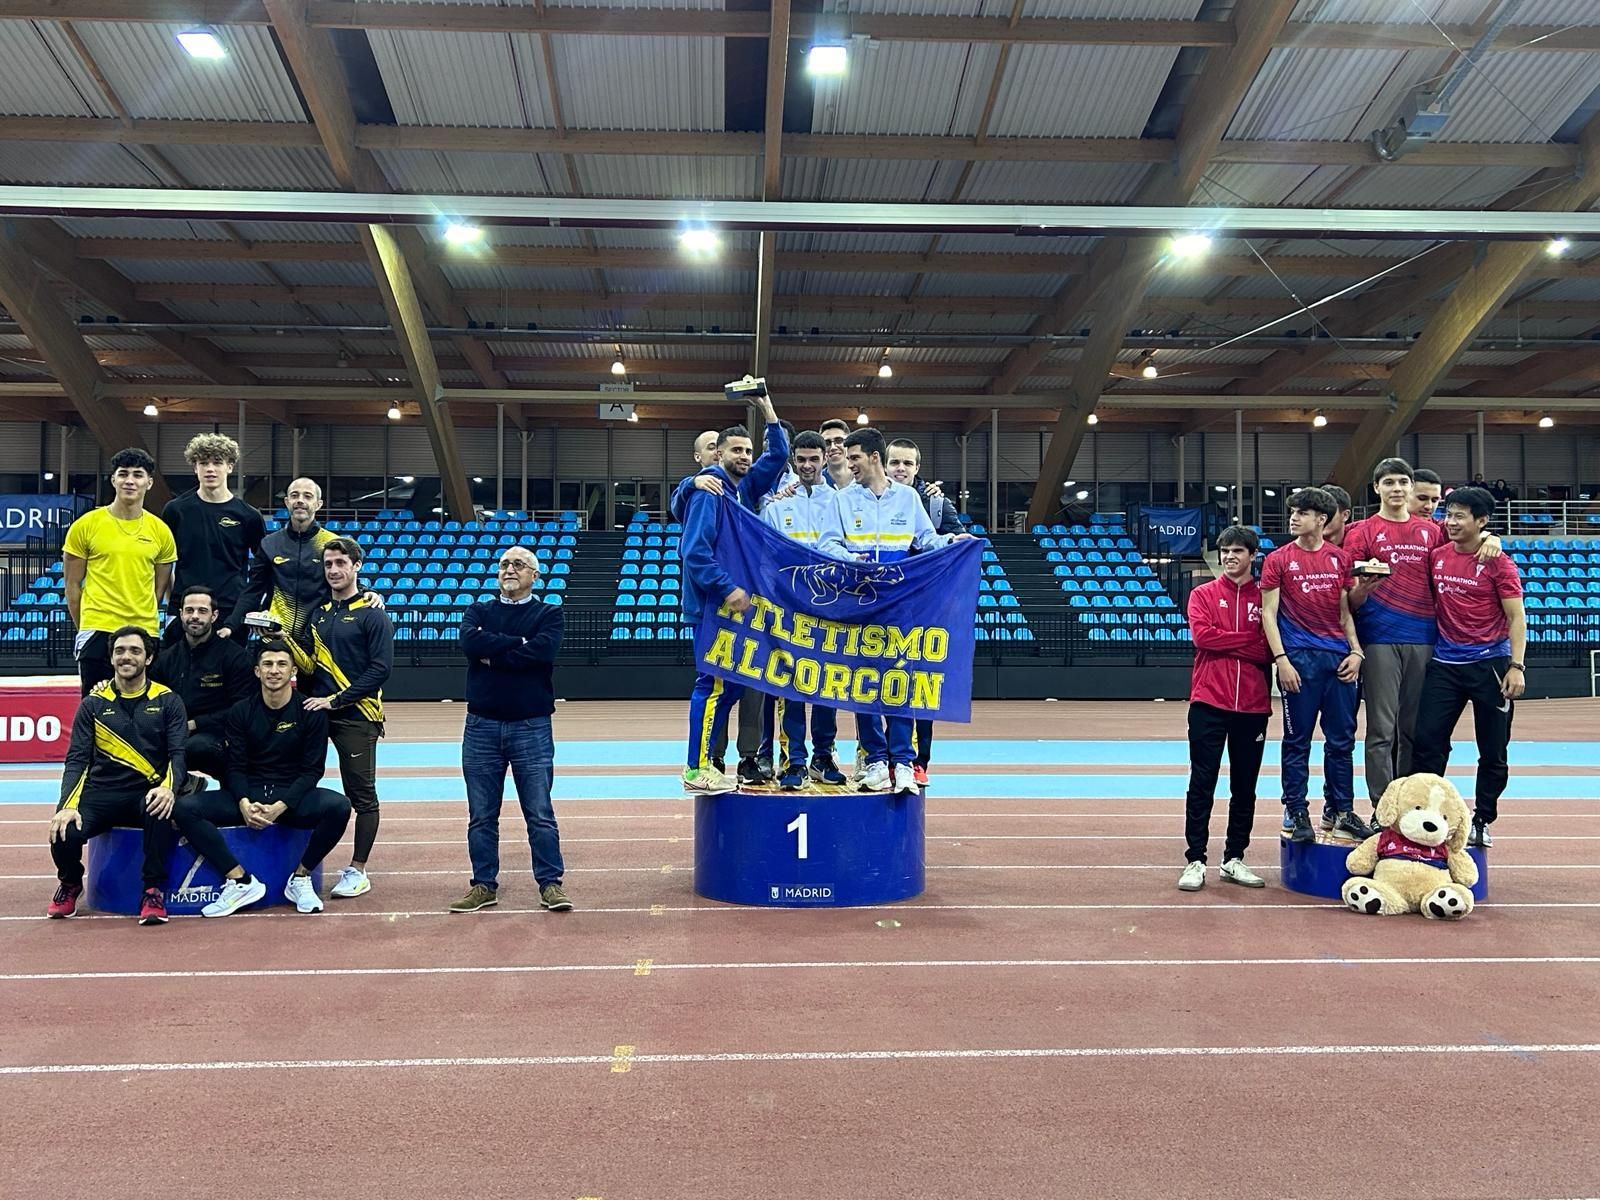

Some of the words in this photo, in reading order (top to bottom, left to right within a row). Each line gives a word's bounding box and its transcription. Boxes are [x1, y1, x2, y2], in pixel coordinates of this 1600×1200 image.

[1395, 544, 1429, 552] MARATHON
[1443, 575, 1478, 586] MARATHON
[717, 594, 950, 662] ATLETISMO
[704, 629, 945, 710] ALCORCÓN
[787, 813, 808, 859] 1
[170, 892, 222, 903] MADRID
[785, 887, 832, 898] MADRID
